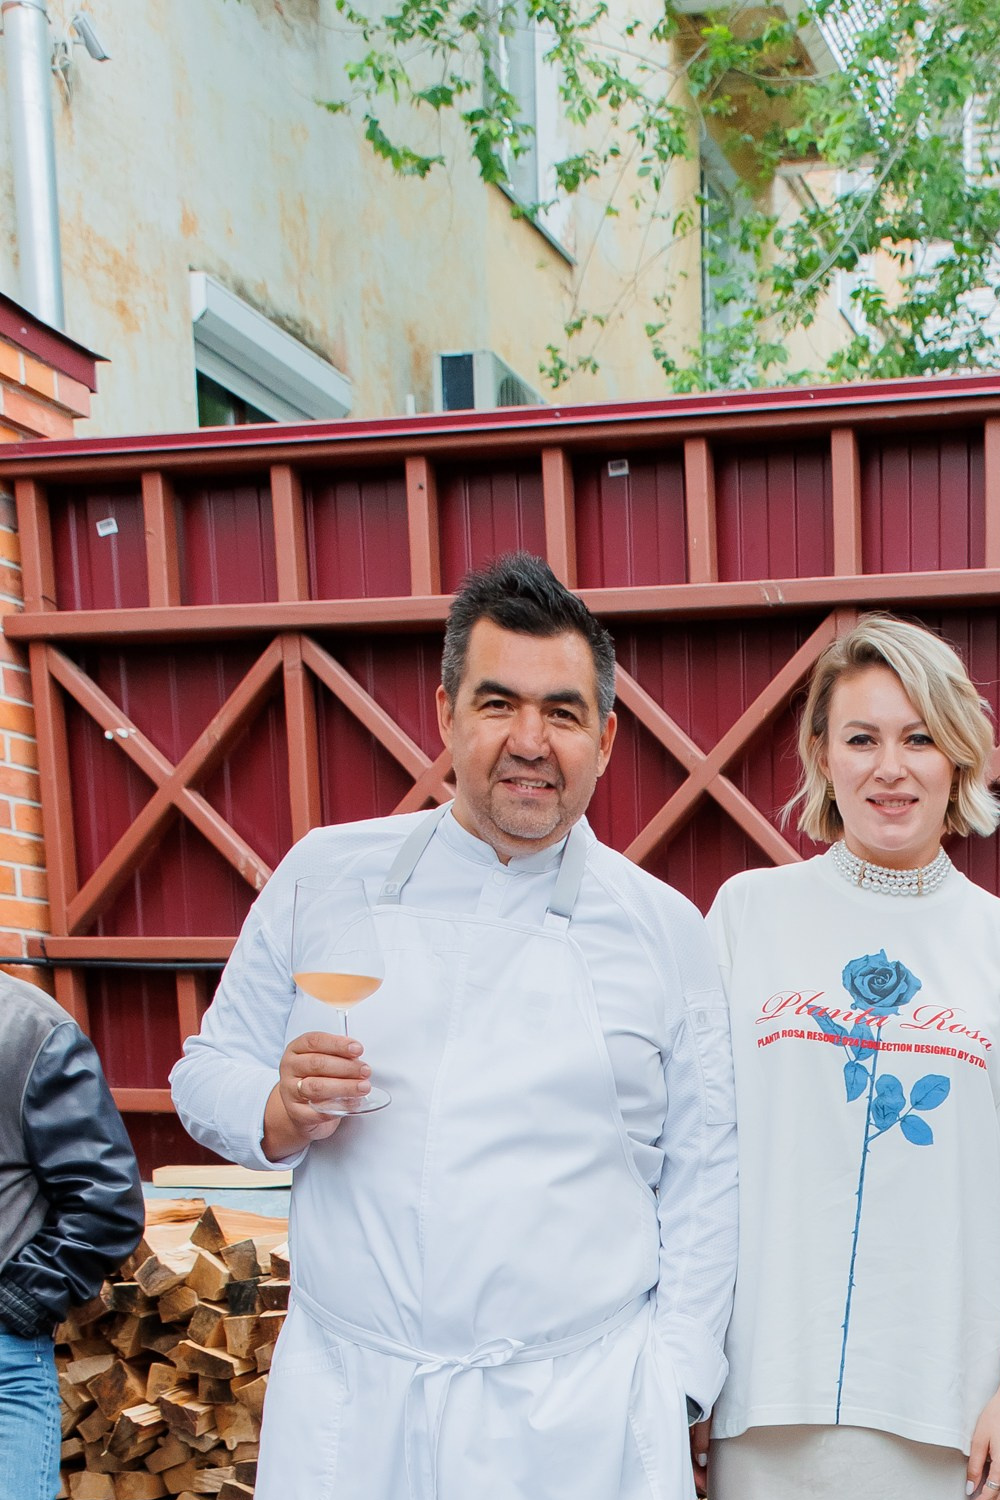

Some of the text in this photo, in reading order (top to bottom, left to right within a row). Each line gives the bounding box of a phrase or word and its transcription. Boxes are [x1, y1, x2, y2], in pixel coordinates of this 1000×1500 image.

[755, 990, 993, 1051] Planta Rosa
[757, 1032, 780, 1048] PLANTA
[781, 1029, 805, 1039] ROSA
[860, 1039, 912, 1052] COLLECTION
[914, 1043, 957, 1057] DESIGNED
[957, 1050, 969, 1061] BY
